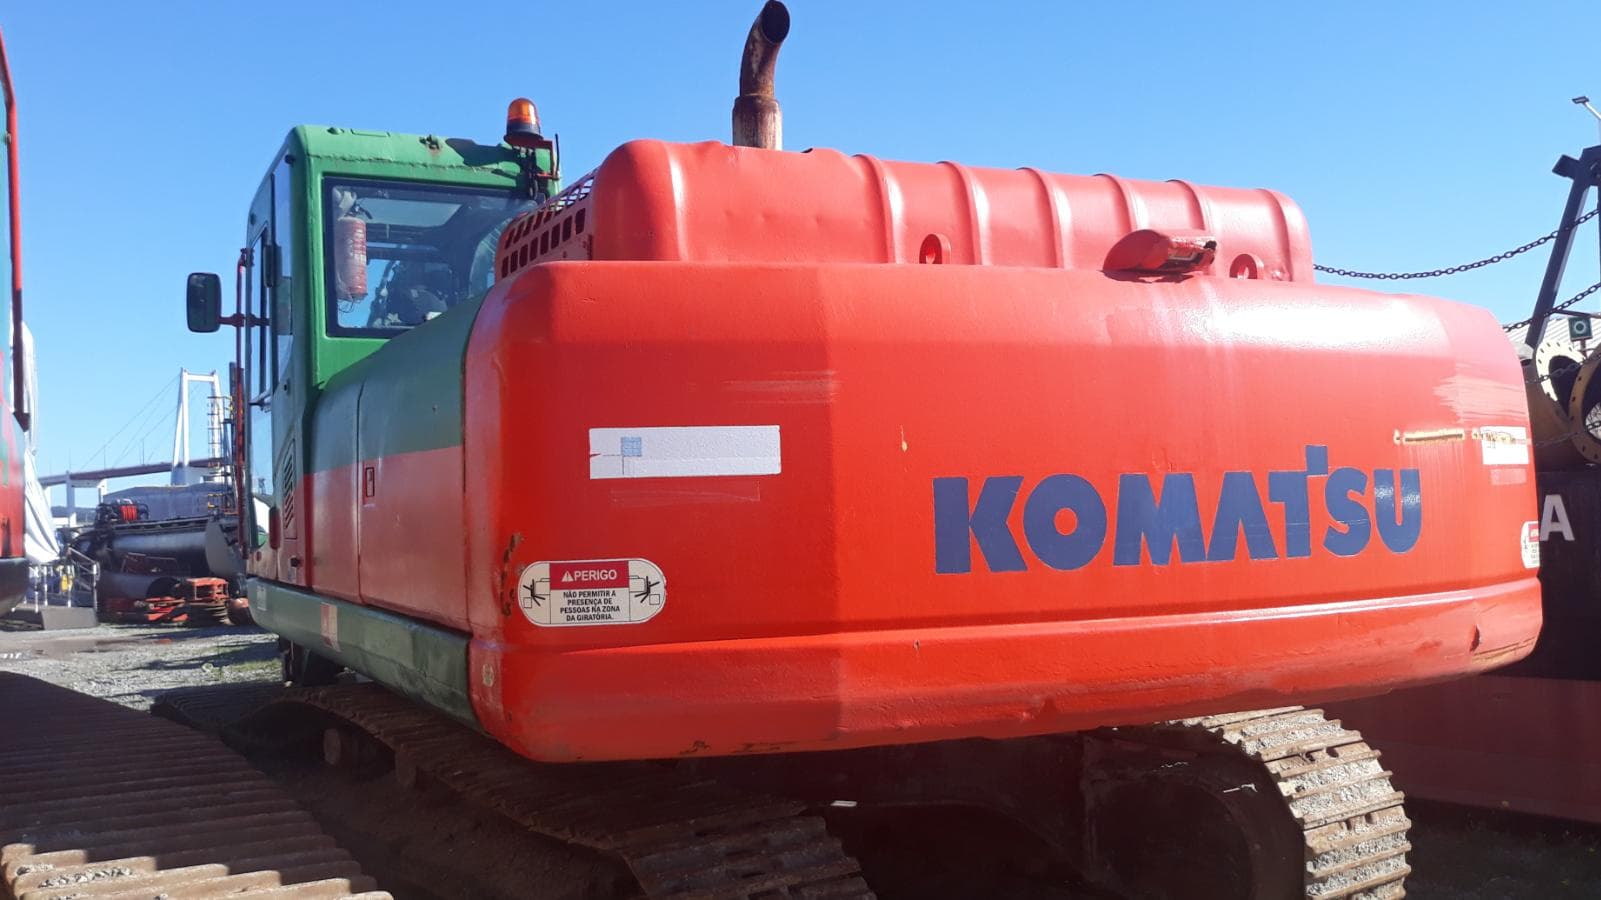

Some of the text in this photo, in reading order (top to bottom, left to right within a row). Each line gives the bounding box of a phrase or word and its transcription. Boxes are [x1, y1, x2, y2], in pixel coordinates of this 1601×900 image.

[932, 445, 1422, 574] KOMATSU
[1539, 494, 1575, 541] A
[574, 569, 618, 582] PERIGO
[563, 590, 577, 598] NÃO
[578, 590, 610, 598] PERMITIR
[567, 598, 602, 606] PRESENÇA
[560, 606, 590, 614] PESSOAS
[602, 605, 620, 613] ZONA
